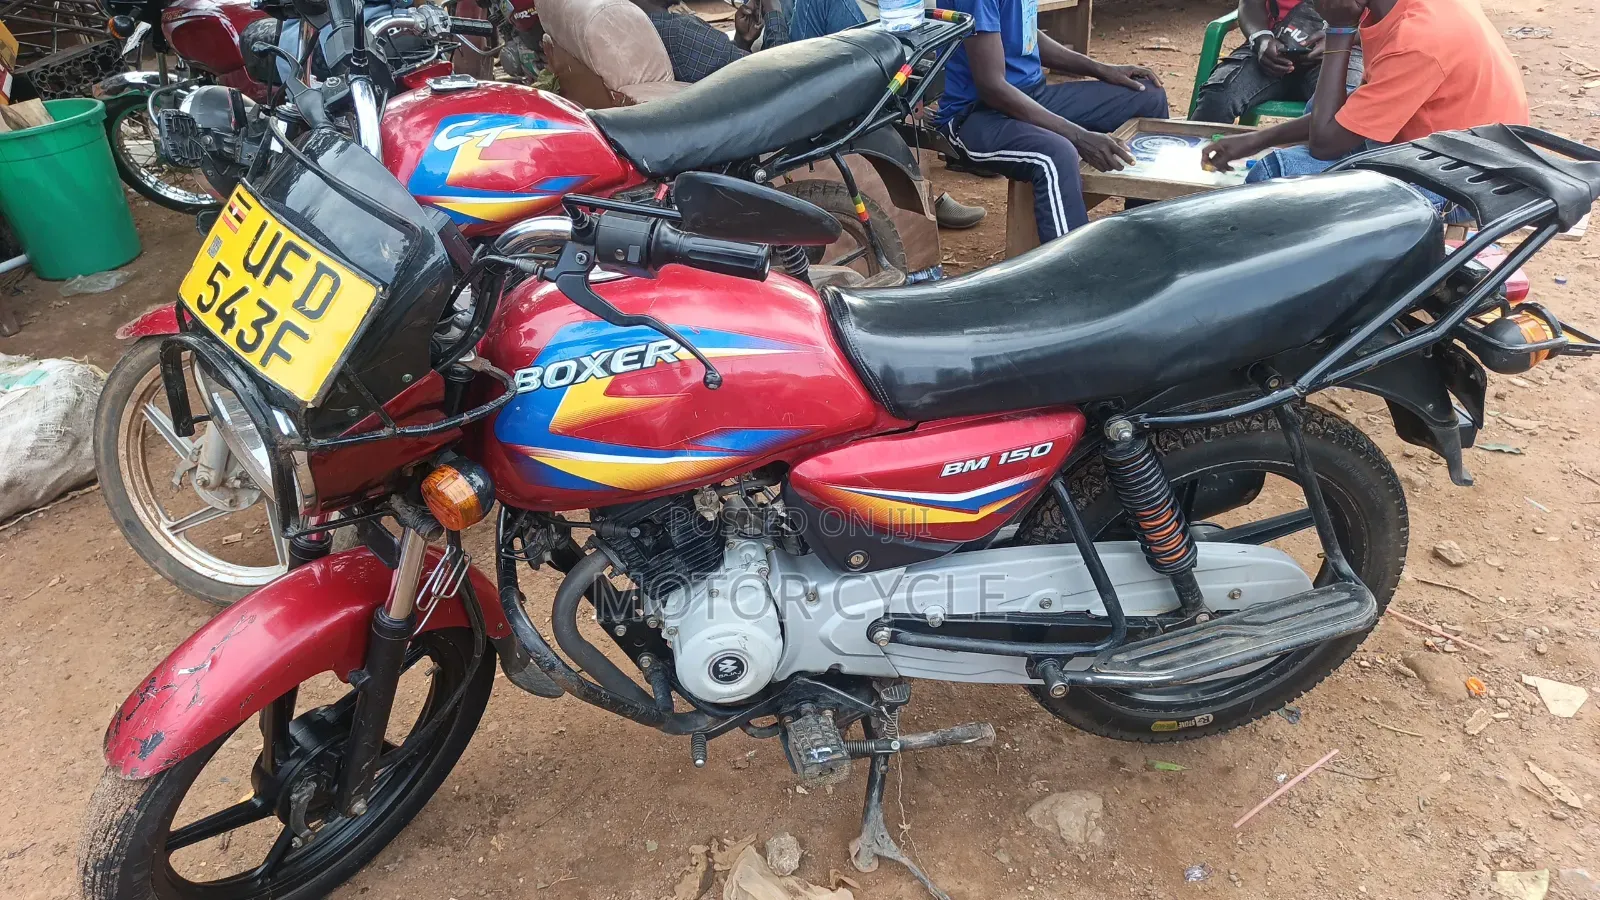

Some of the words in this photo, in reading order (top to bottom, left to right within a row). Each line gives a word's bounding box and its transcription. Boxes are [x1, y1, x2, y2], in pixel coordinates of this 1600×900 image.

[434, 119, 521, 151] CT
[243, 219, 341, 321] UFD
[196, 261, 310, 368] 543F
[514, 338, 681, 395] BOXER
[940, 456, 991, 477] BM
[998, 441, 1054, 465] 150
[718, 670, 742, 679] BAJAJ
